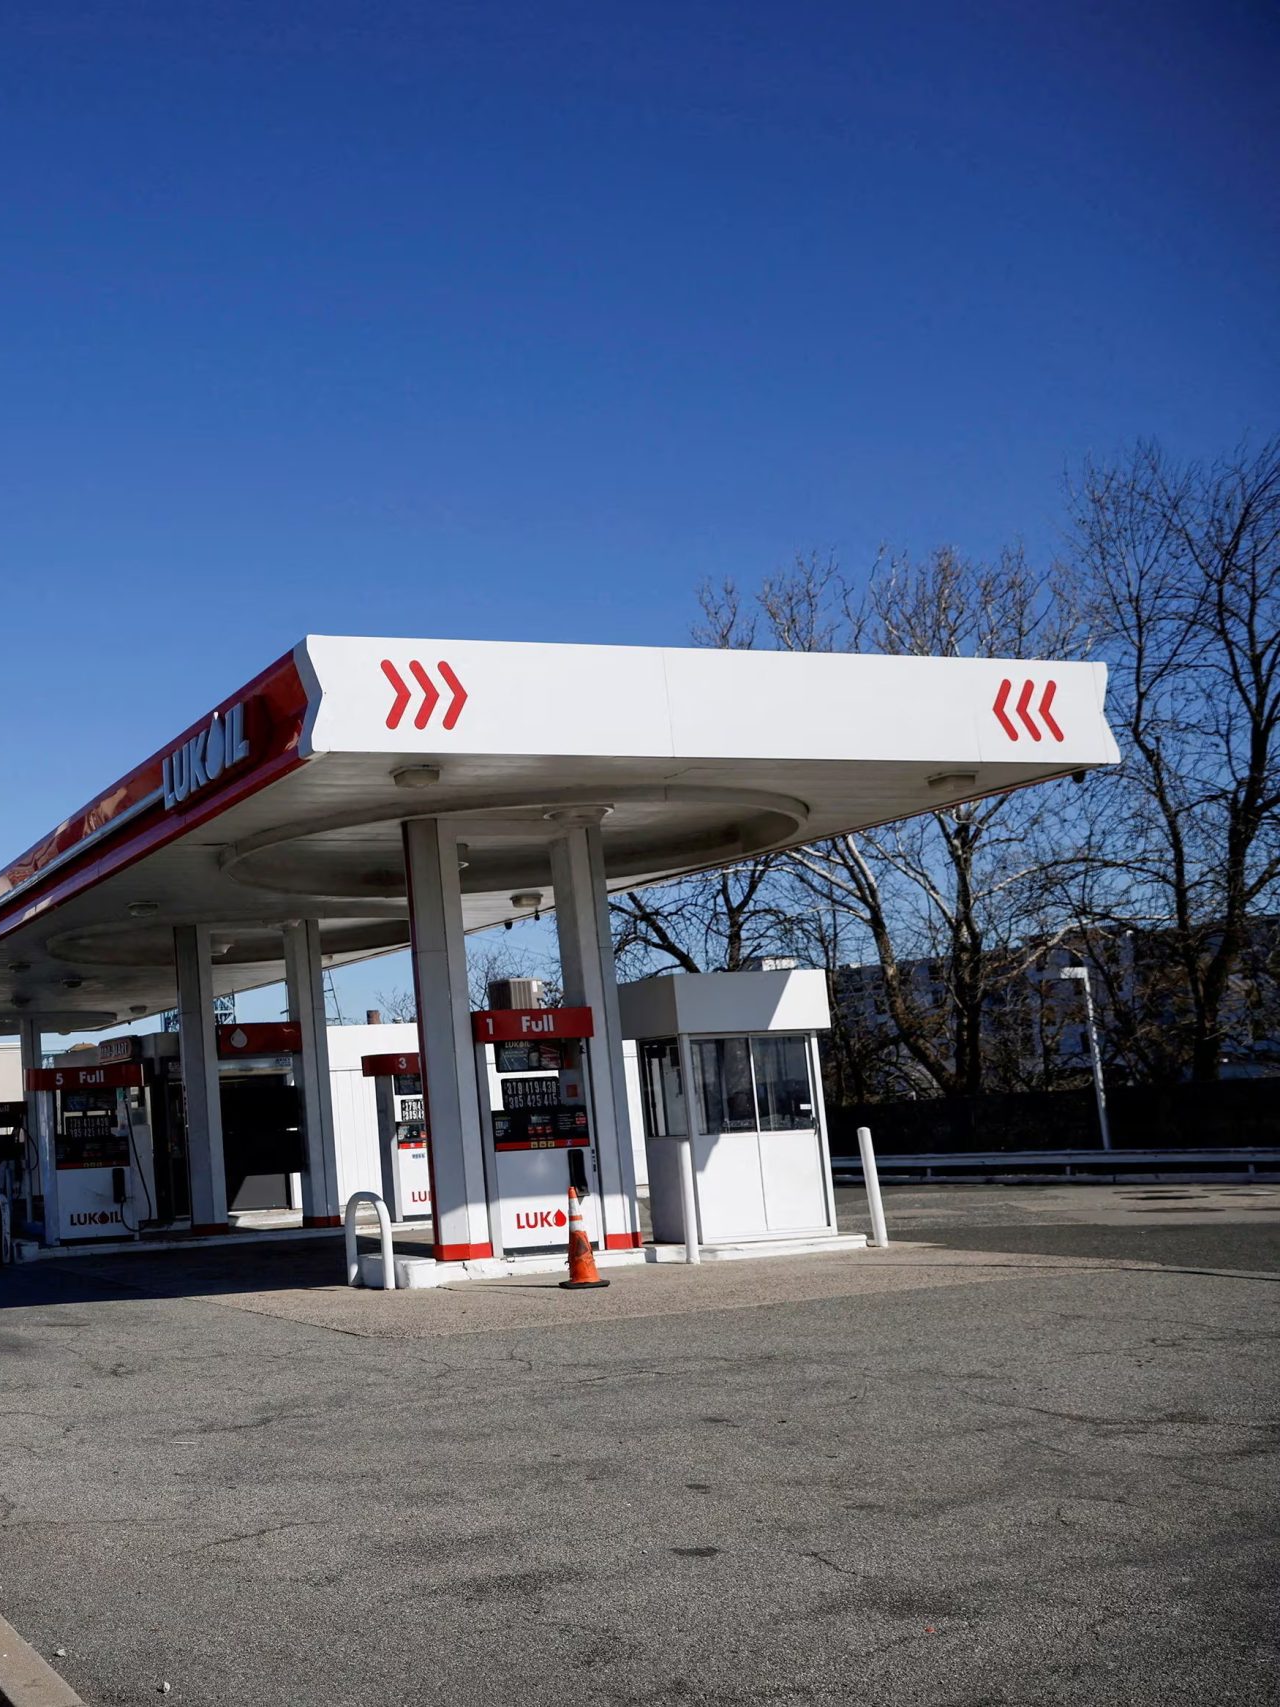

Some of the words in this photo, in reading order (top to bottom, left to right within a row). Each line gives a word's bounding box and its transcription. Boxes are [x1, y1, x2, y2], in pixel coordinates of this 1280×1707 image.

[162, 702, 250, 811] LUKOIL
[486, 1018, 494, 1035] 1
[521, 1014, 554, 1033] Full
[504, 1040, 530, 1049] LUKOIL
[398, 1057, 407, 1070] 3
[55, 1073, 64, 1085] 5
[79, 1070, 104, 1083] Full
[70, 1211, 122, 1226] LUKOIL
[516, 1208, 567, 1229] LUKO
